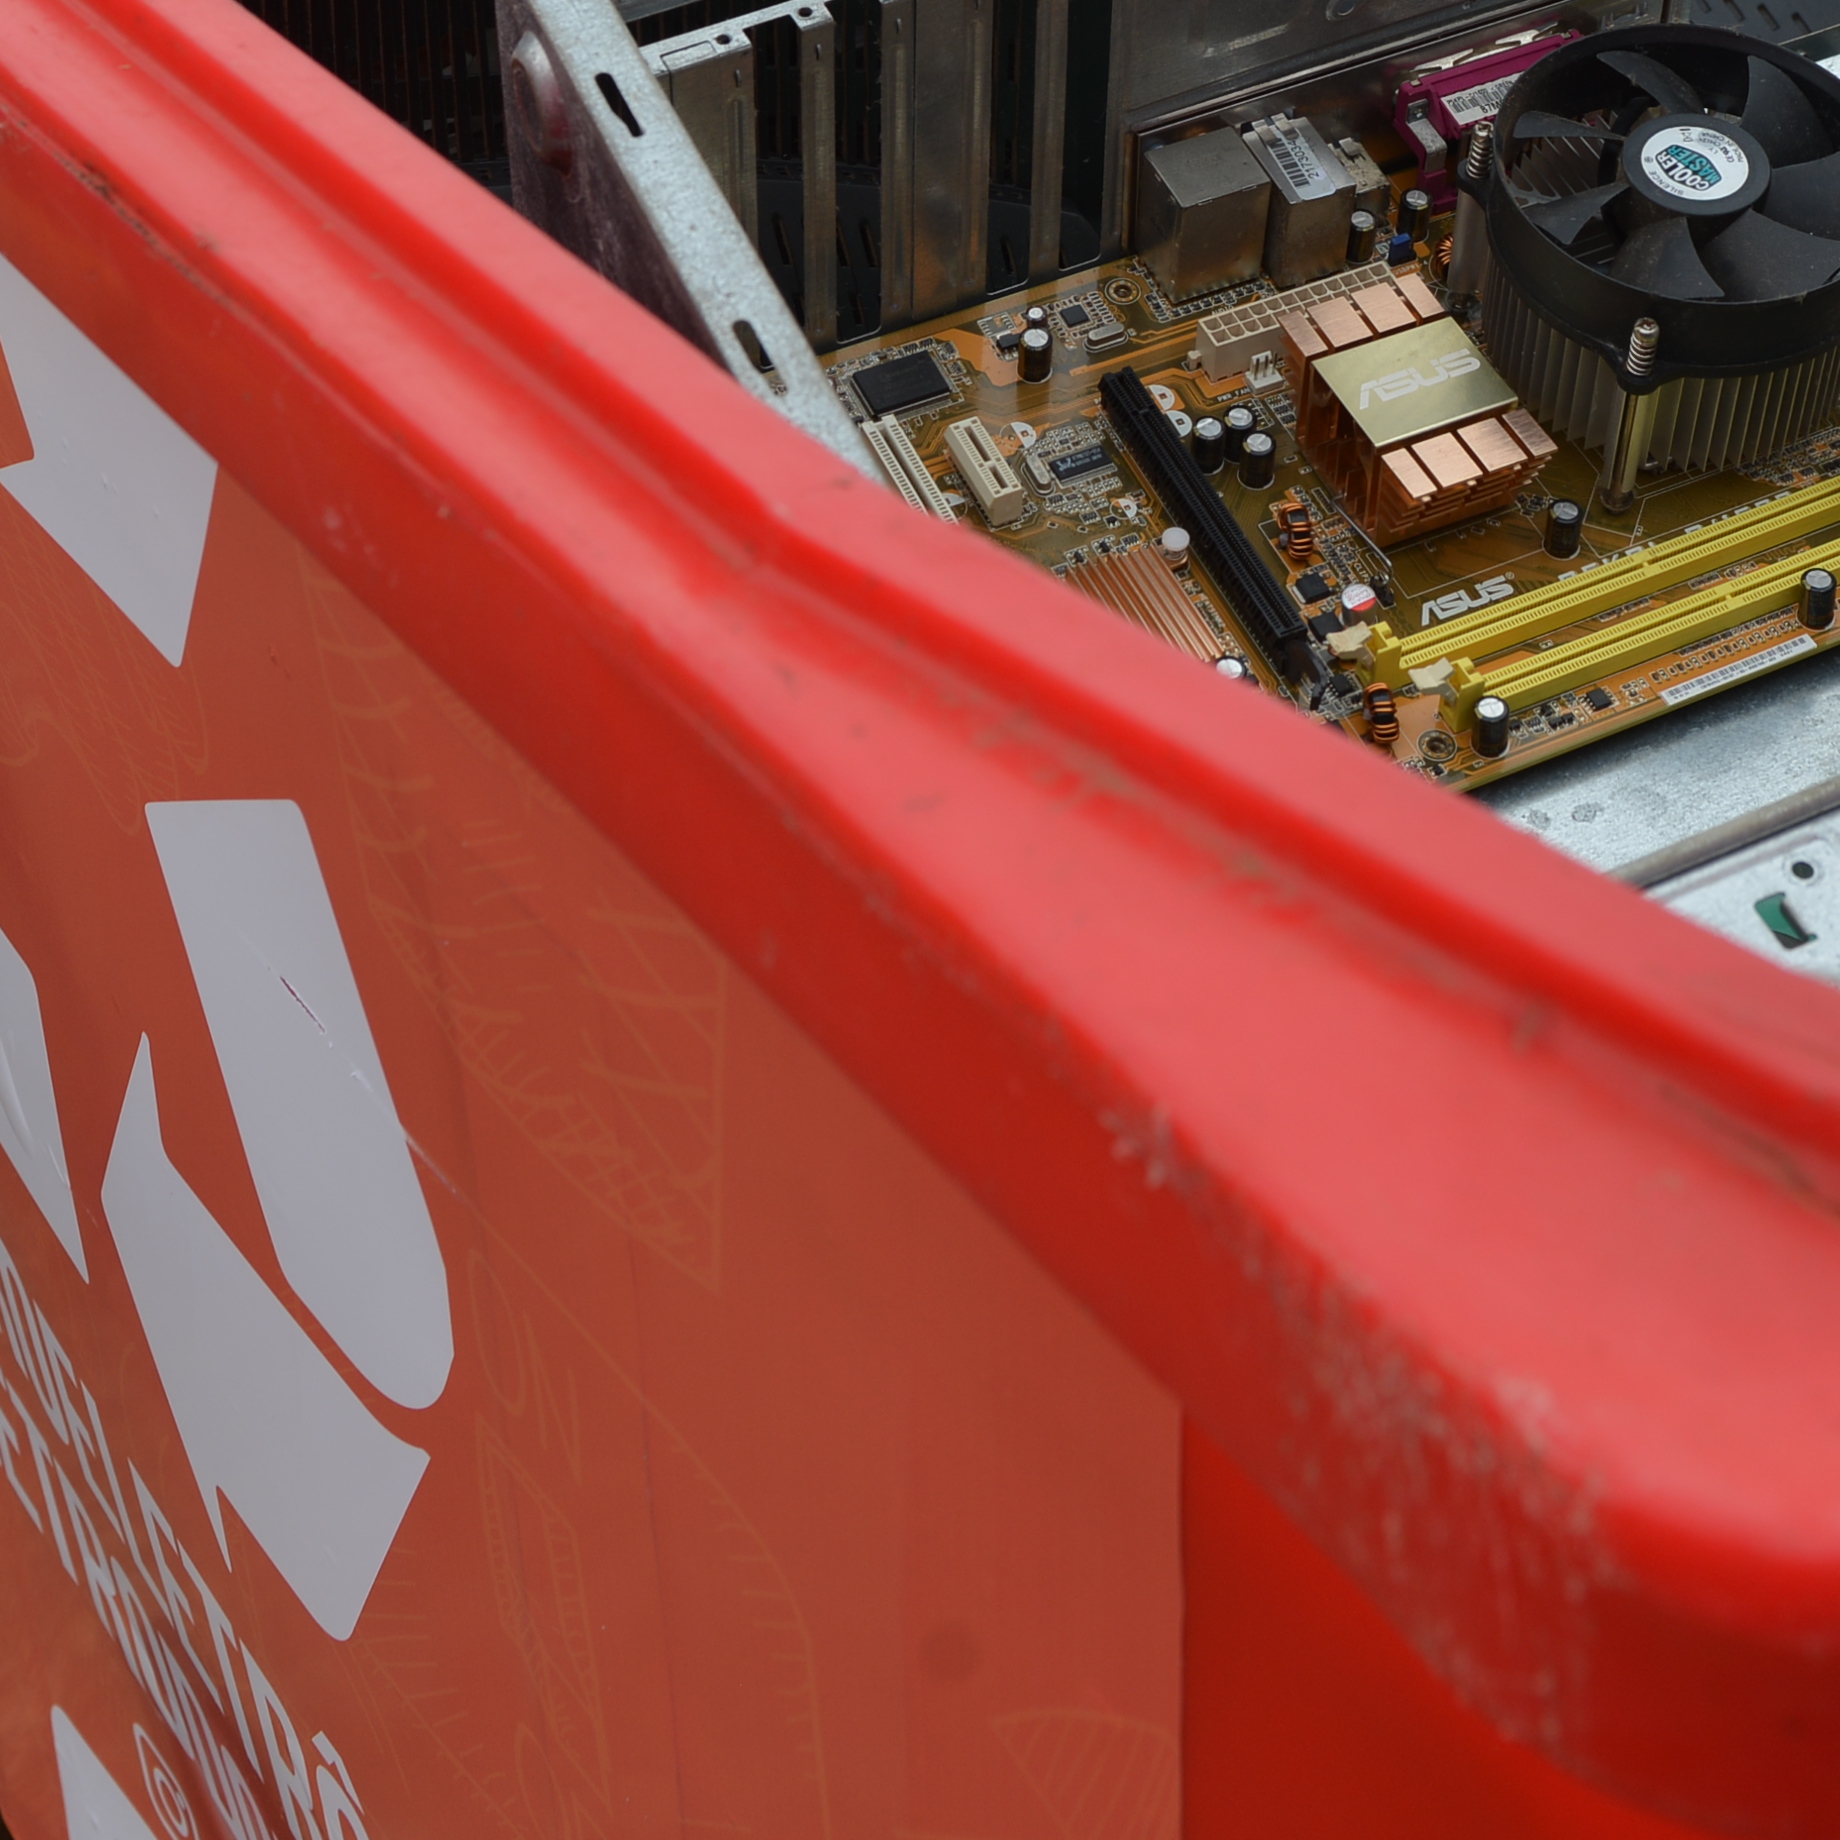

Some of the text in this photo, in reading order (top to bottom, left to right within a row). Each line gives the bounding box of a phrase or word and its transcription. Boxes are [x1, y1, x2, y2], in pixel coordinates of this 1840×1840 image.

[1656, 151, 1710, 190] COOLER
[1667, 145, 1719, 183] MASTER
[1360, 348, 1481, 410] ASUS
[1421, 574, 1514, 626] ASUS
